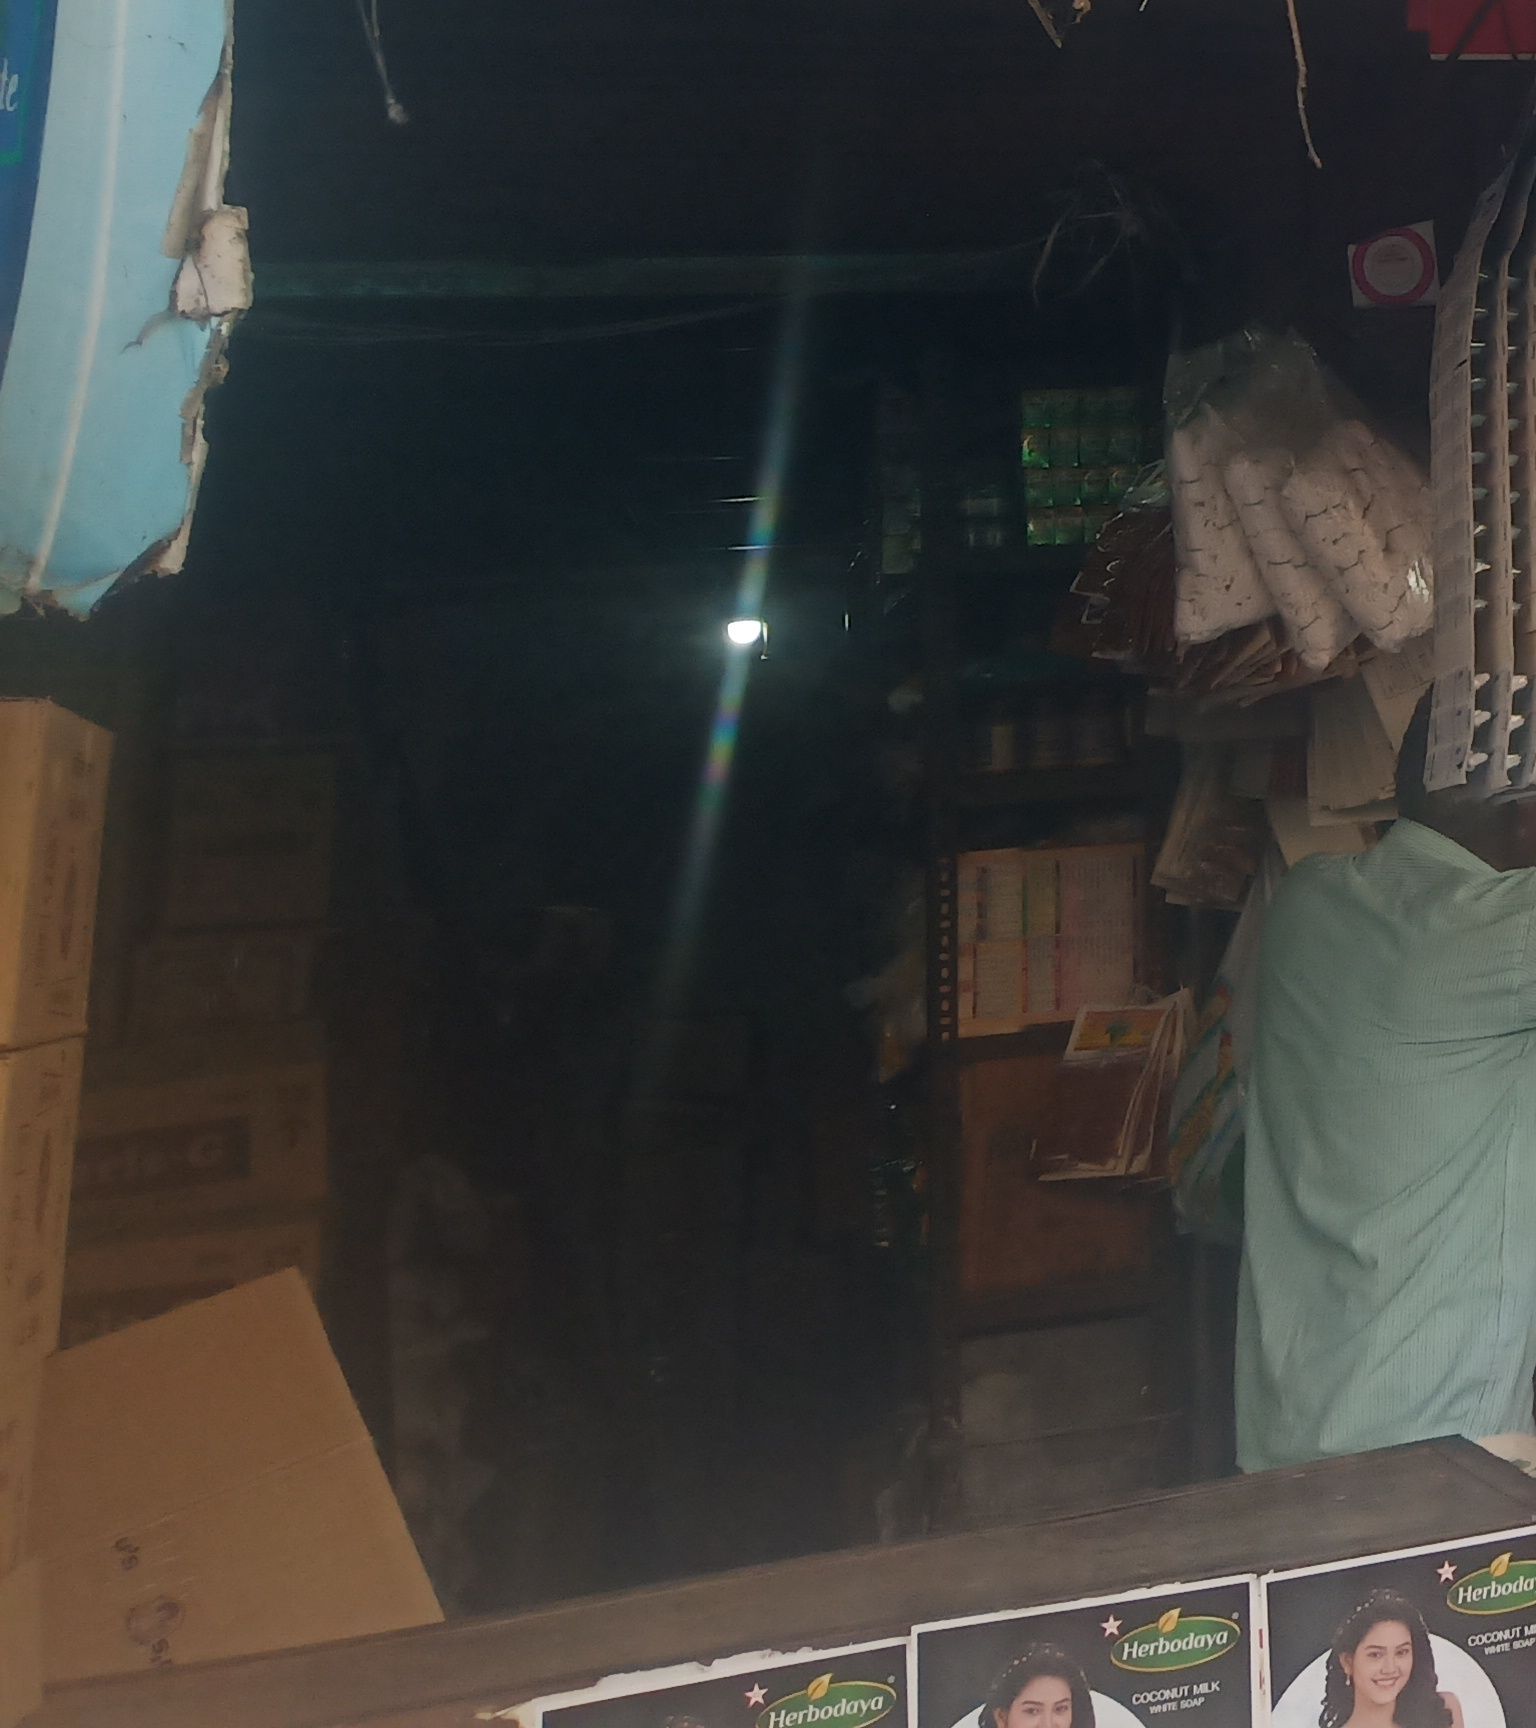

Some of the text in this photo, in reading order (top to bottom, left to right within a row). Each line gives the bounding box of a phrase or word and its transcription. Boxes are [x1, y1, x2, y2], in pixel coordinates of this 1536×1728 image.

[1120, 1627, 1230, 1662] Herbodaya
[1467, 1626, 1523, 1648] COCONUT
[1131, 1679, 1222, 1706] COCONUT MILK
[766, 1691, 886, 1728] Herbodaya
